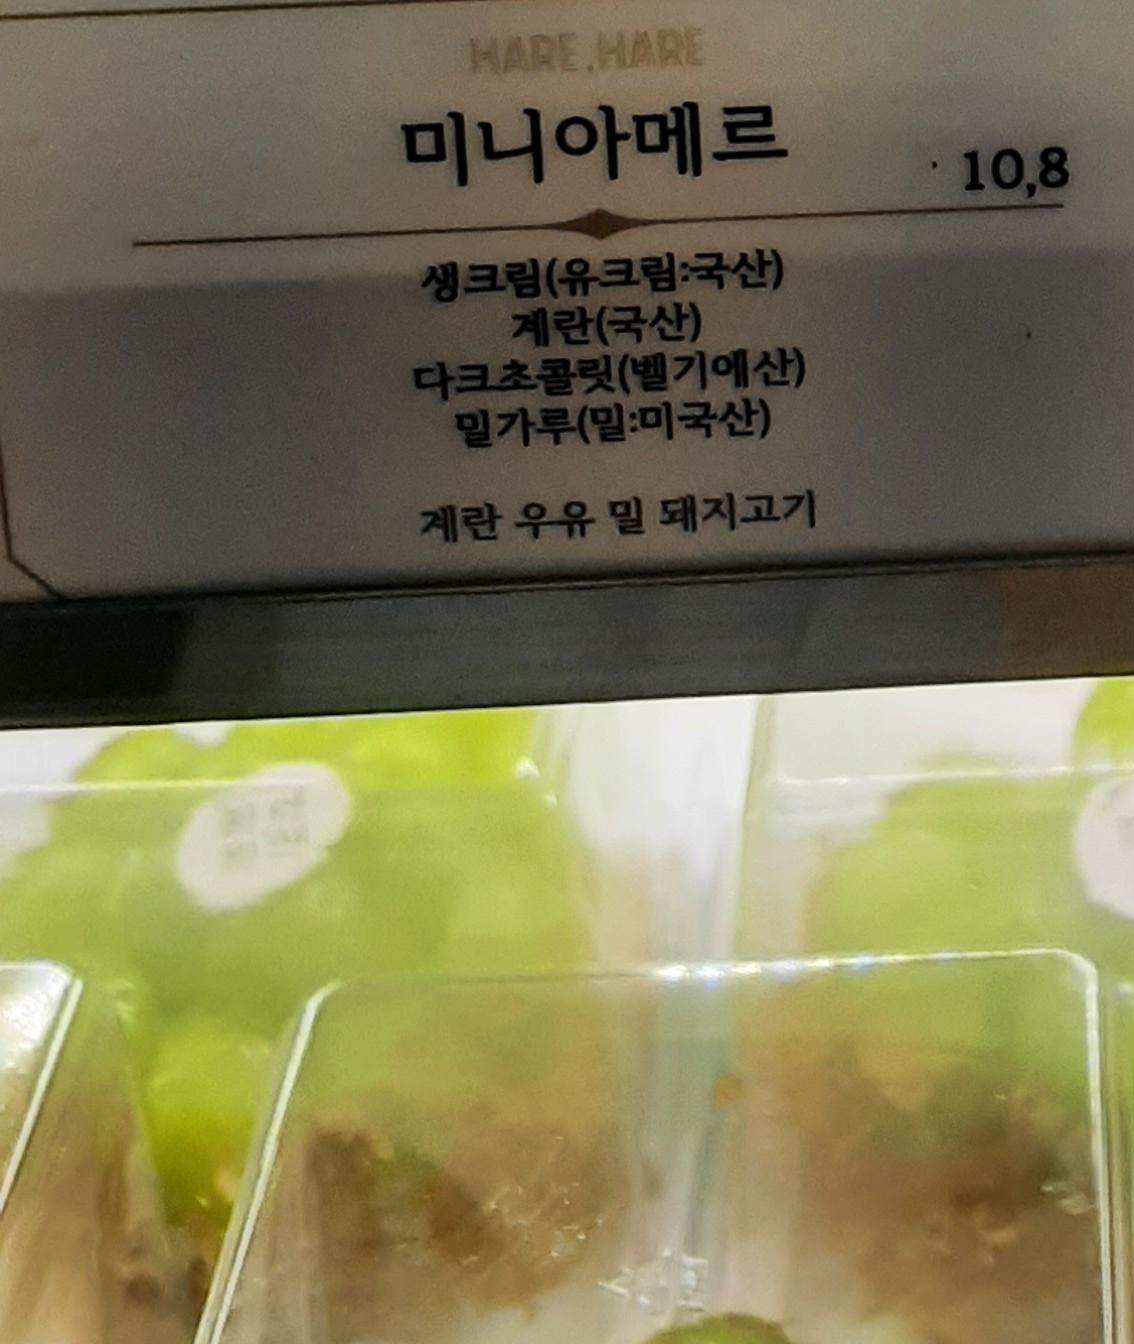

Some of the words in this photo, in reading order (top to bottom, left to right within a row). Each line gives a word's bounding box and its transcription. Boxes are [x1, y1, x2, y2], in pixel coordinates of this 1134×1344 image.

[400, 101, 789, 187] 미니아메르
[962, 147, 1071, 197] 10,8
[421, 248, 784, 303] 생크림(유크림:국산)
[512, 302, 702, 346] 계란(국산)
[413, 347, 806, 400] 다크초콜릿(벨기에산)
[456, 398, 772, 448] 밀가루(밀:미국산)
[421, 503, 502, 543] 계란
[513, 502, 595, 539] 우유
[608, 496, 646, 535] 밀
[659, 489, 817, 533] 돼지고기
